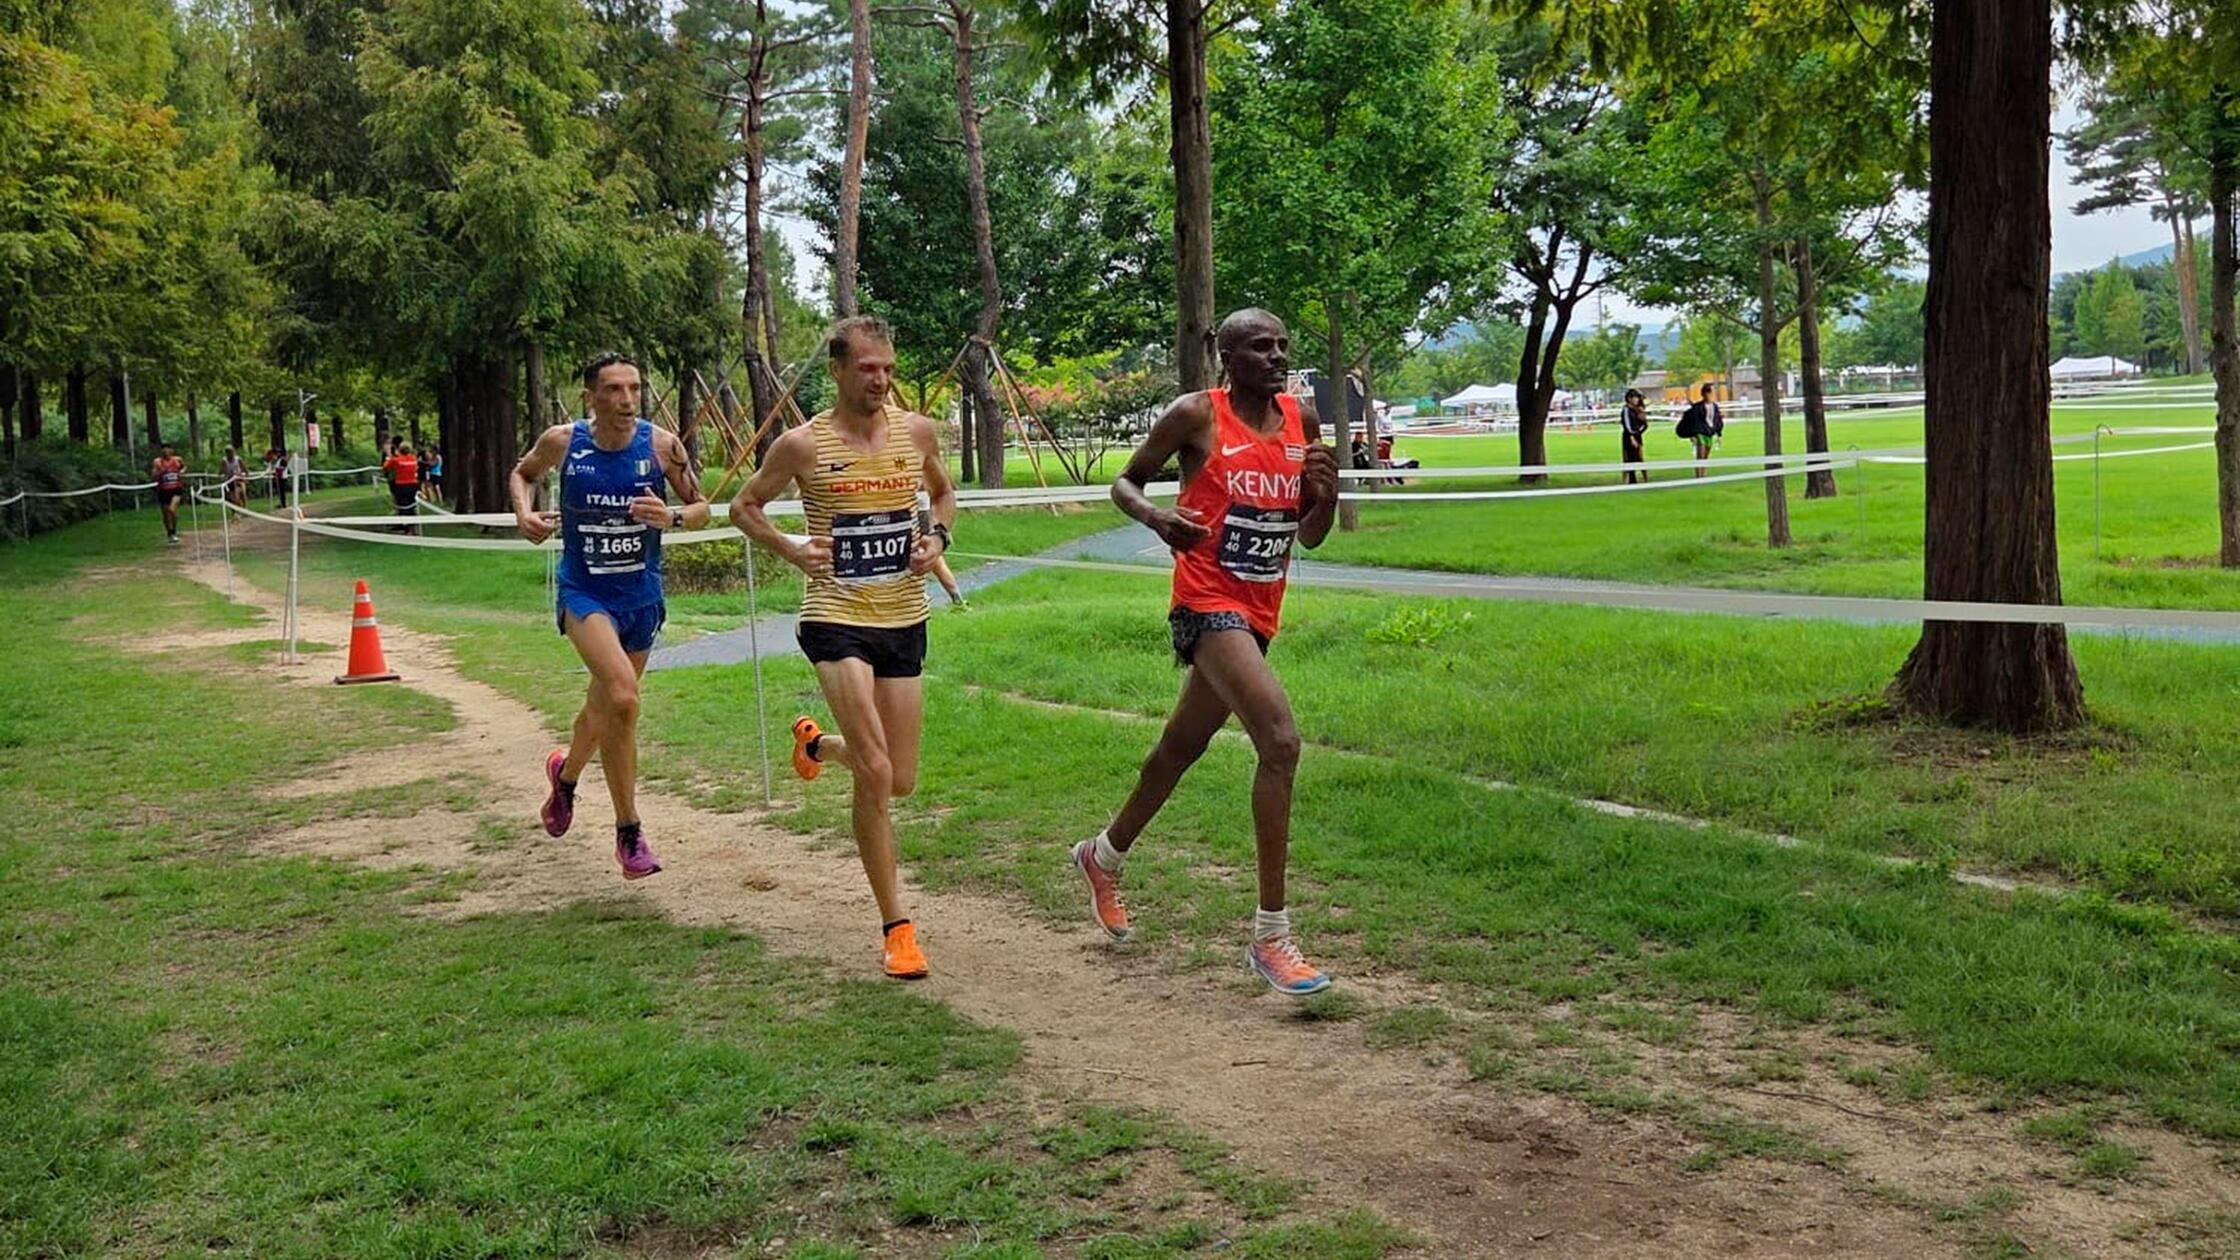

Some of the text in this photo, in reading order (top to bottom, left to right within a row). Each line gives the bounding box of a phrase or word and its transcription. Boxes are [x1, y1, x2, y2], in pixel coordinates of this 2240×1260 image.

[831, 477, 912, 493] GERMANY
[1227, 470, 1301, 499] KENYA
[1230, 531, 1241, 541] M
[600, 536, 642, 554] 1665
[841, 541, 851, 550] M
[861, 536, 907, 560] 1107
[839, 550, 853, 560] 40
